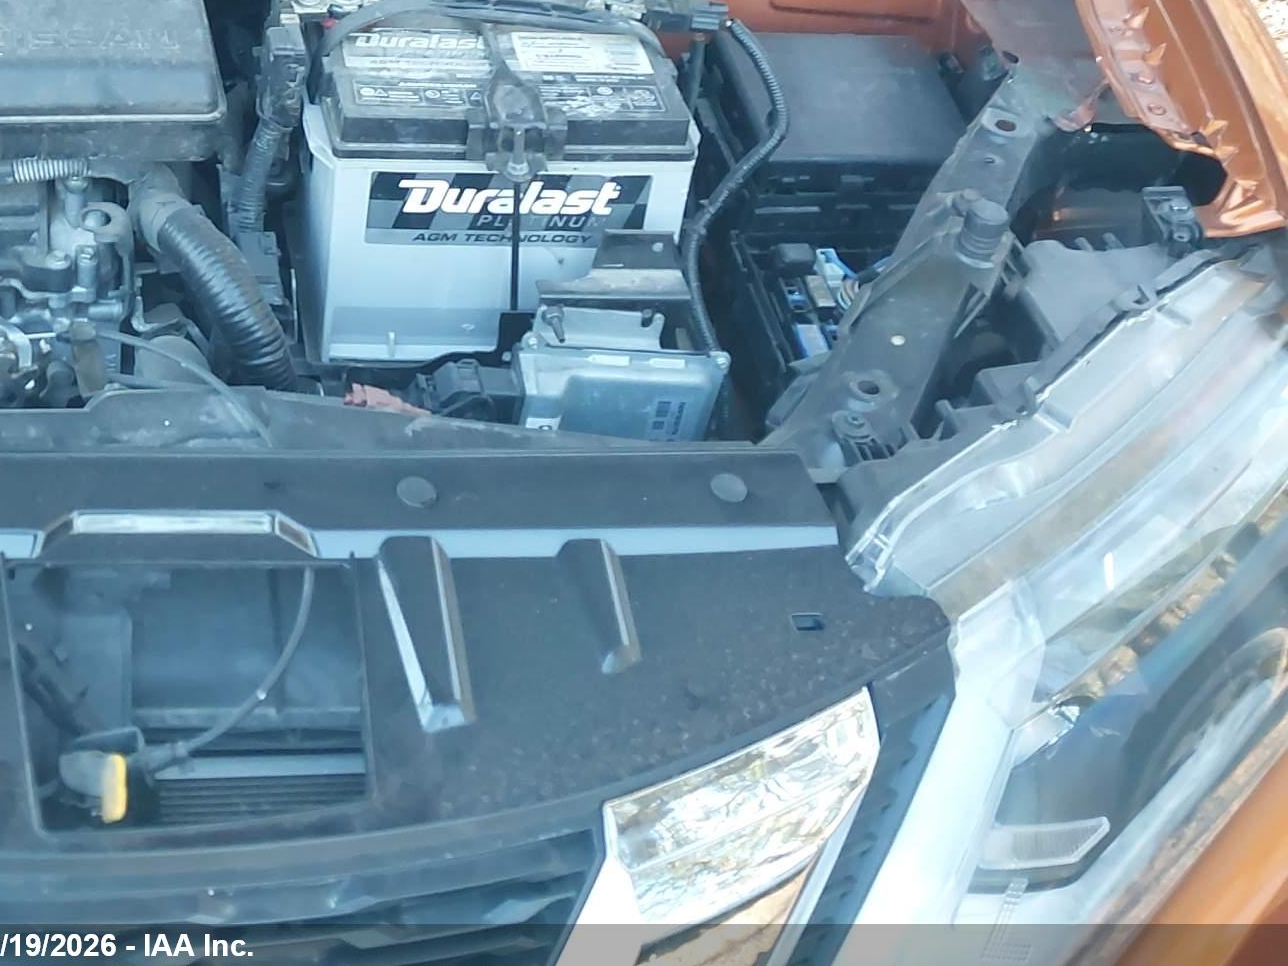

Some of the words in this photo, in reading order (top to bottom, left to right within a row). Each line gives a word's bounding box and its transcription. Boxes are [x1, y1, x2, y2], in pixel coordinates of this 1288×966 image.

[398, 179, 622, 215] Duralast
[413, 233, 456, 242] AGM
[464, 233, 593, 244] TECHNOLOGY
